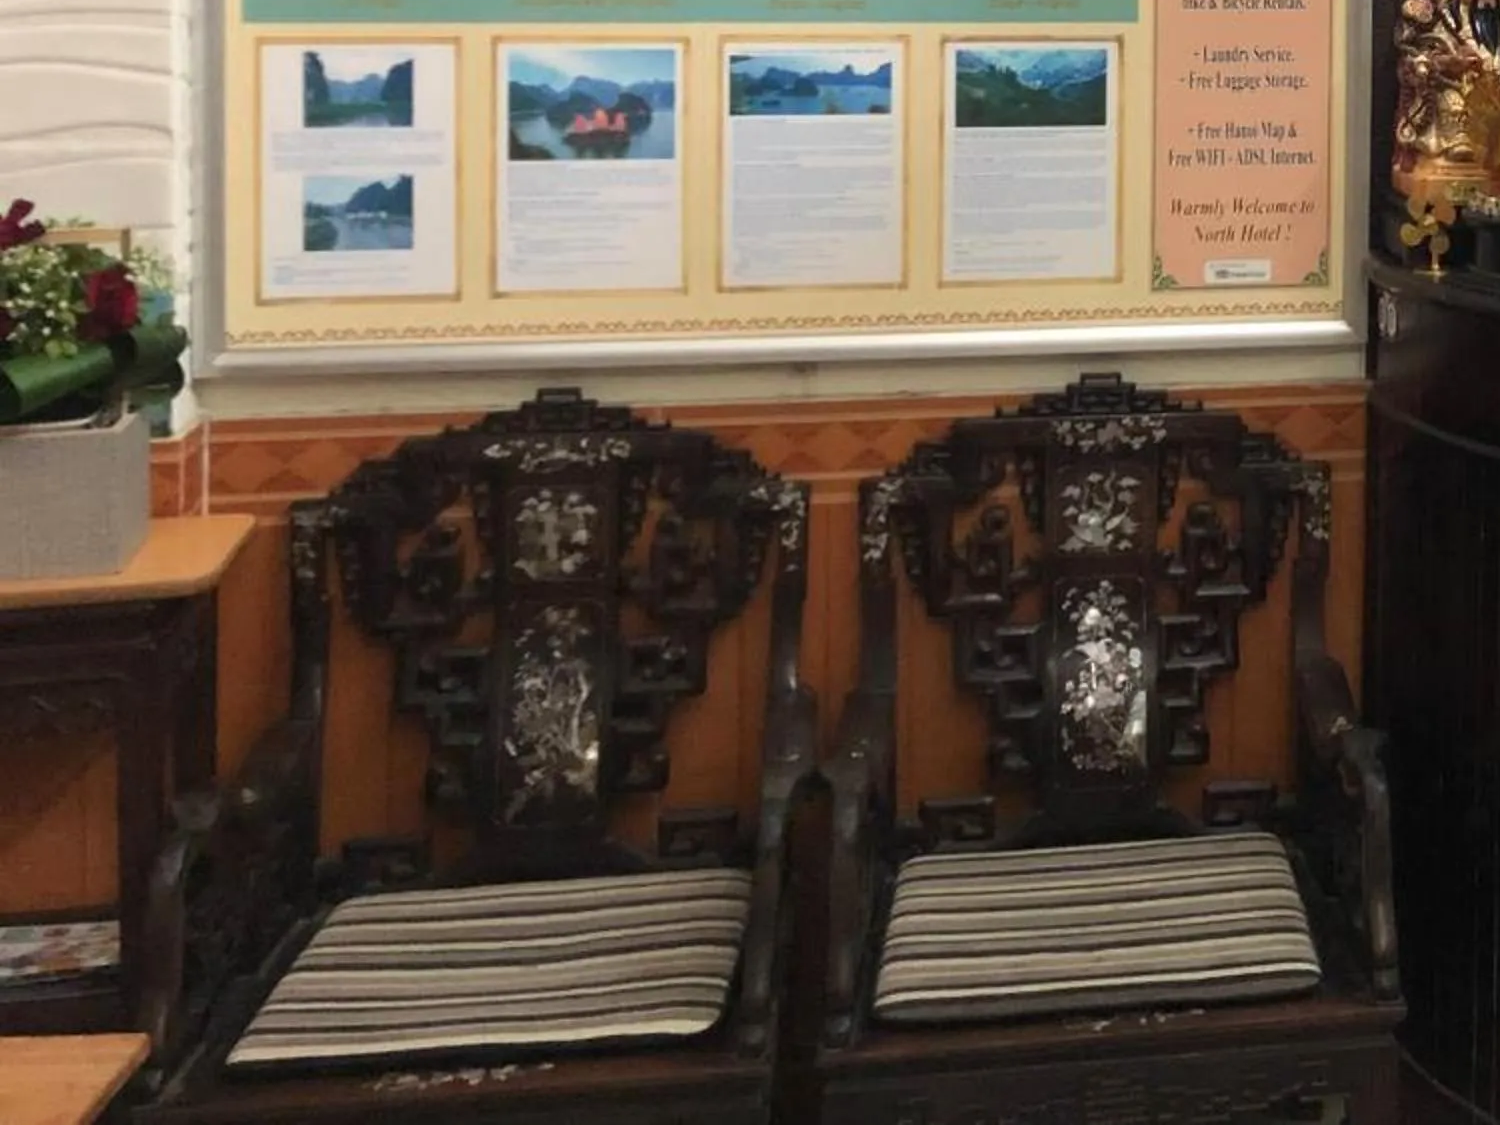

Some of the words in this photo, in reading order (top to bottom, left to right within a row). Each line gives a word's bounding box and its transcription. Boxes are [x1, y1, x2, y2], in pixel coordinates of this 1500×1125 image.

[1203, 45, 1249, 68] Laundry
[1252, 46, 1295, 63] Service.
[1189, 70, 1213, 89] Free
[1216, 71, 1262, 91] Luggage
[1265, 73, 1309, 91] Storage.
[1197, 122, 1223, 139] Free
[1225, 122, 1258, 139] Hanoi
[1261, 121, 1285, 143] Map
[1288, 122, 1297, 138] &
[1168, 148, 1192, 167] Free
[1195, 148, 1226, 166] WIFI
[1236, 148, 1269, 165] ADSL
[1170, 197, 1224, 219] Warmly
[1233, 196, 1297, 215] Welcome
[1300, 199, 1315, 214] to
[1195, 225, 1235, 242] North
[1241, 224, 1282, 242] Hotel
[1285, 225, 1292, 241] !
